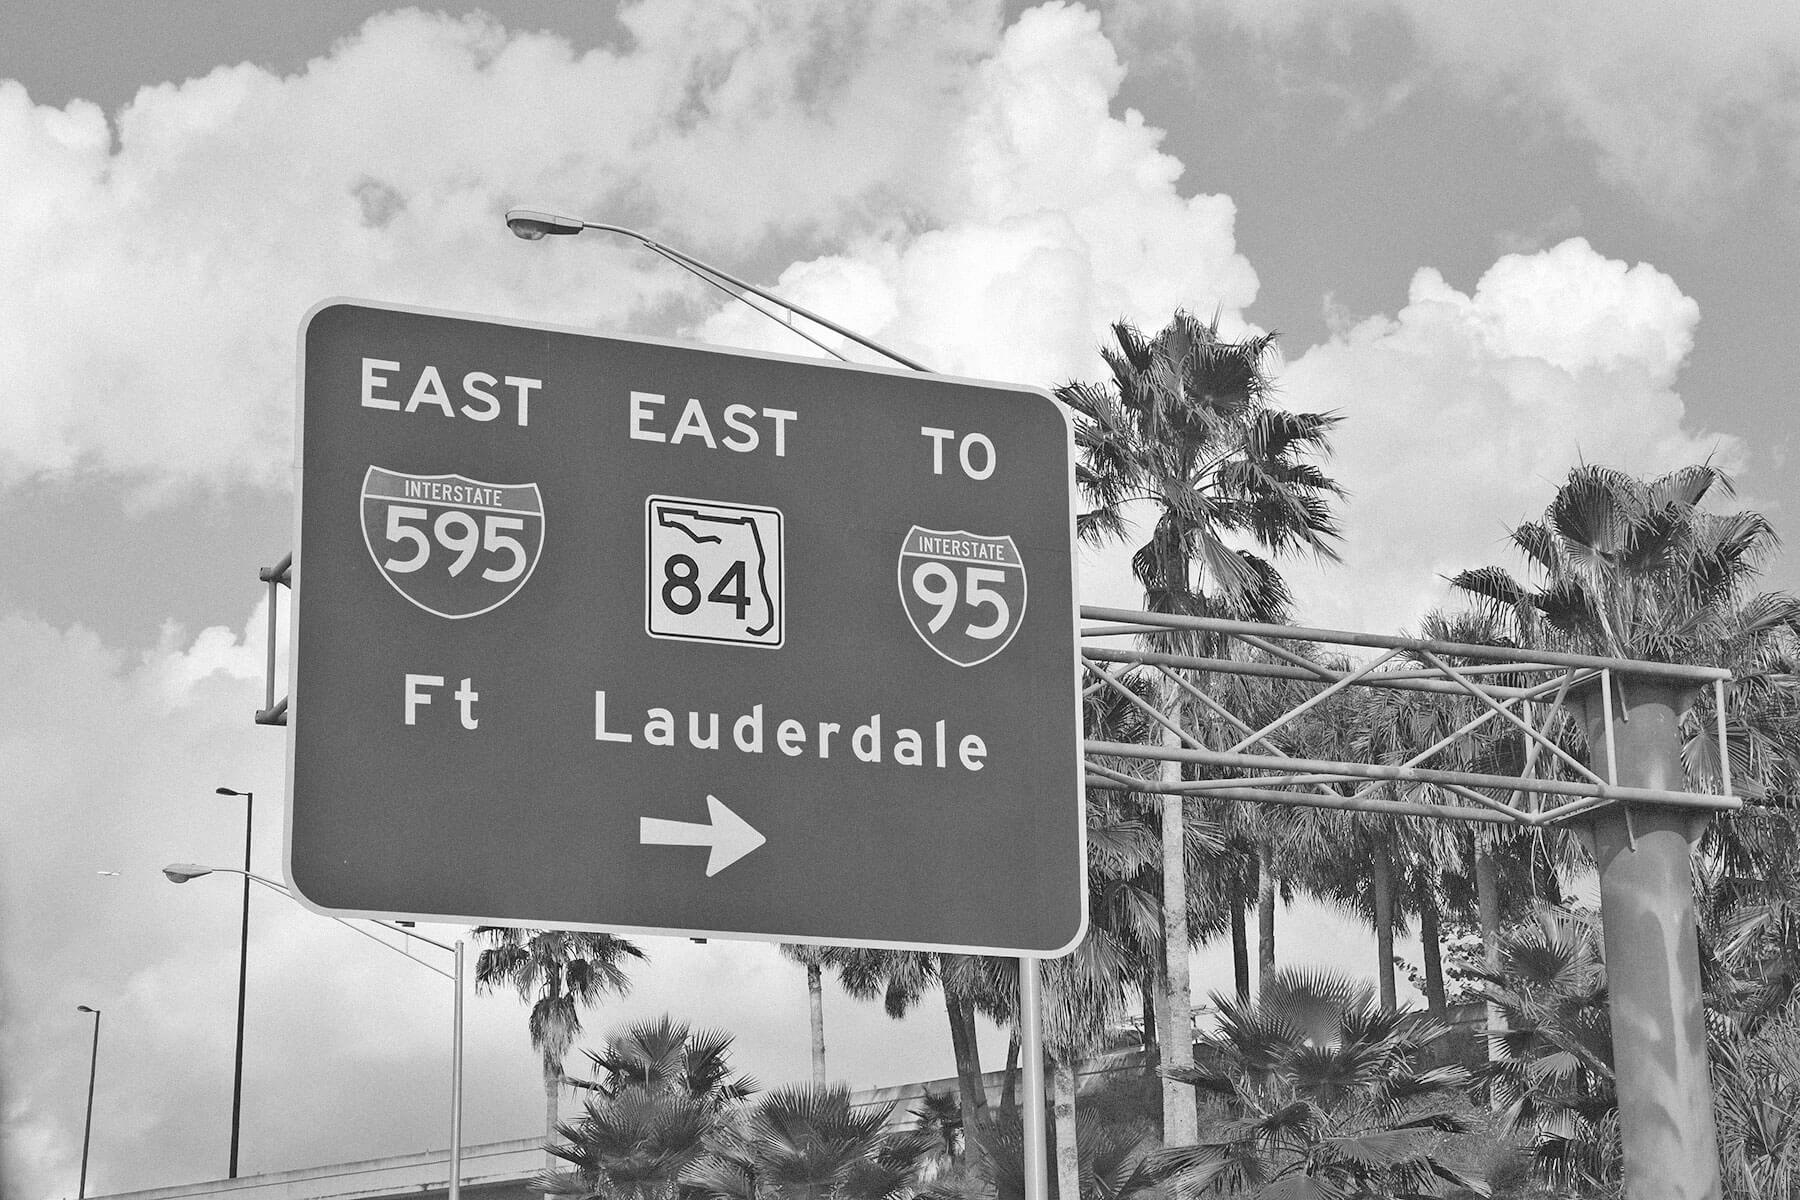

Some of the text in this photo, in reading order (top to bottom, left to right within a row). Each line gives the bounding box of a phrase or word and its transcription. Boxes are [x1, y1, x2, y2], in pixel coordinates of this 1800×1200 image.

[360, 357, 543, 427] EAST
[629, 390, 798, 457] EAST
[921, 426, 998, 481] TO
[404, 479, 503, 507] INTERSTATE
[384, 504, 527, 583] 595
[918, 535, 1005, 562] INTERSTATE
[661, 553, 752, 622] 84
[912, 561, 1010, 640] 95
[404, 673, 988, 772] Ft Lauderdale
